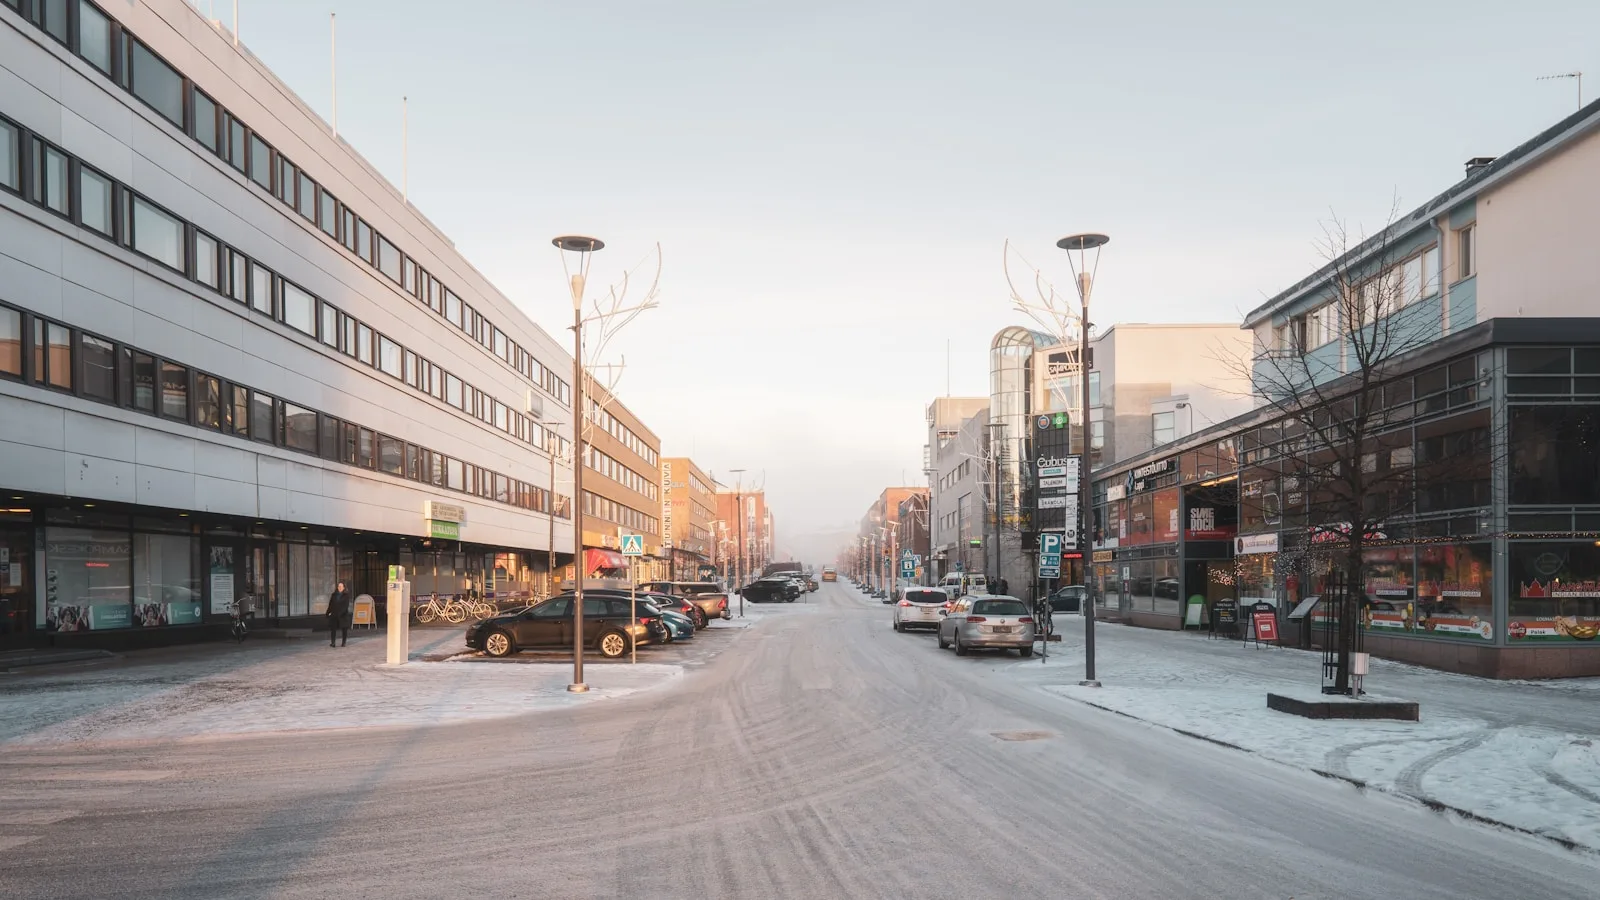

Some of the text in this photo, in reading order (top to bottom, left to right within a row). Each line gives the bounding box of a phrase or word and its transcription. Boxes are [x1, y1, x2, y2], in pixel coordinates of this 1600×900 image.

[1037, 456, 1067, 467] Cubus
[1190, 518, 1215, 531] ROCK
[1044, 535, 1058, 552] P
